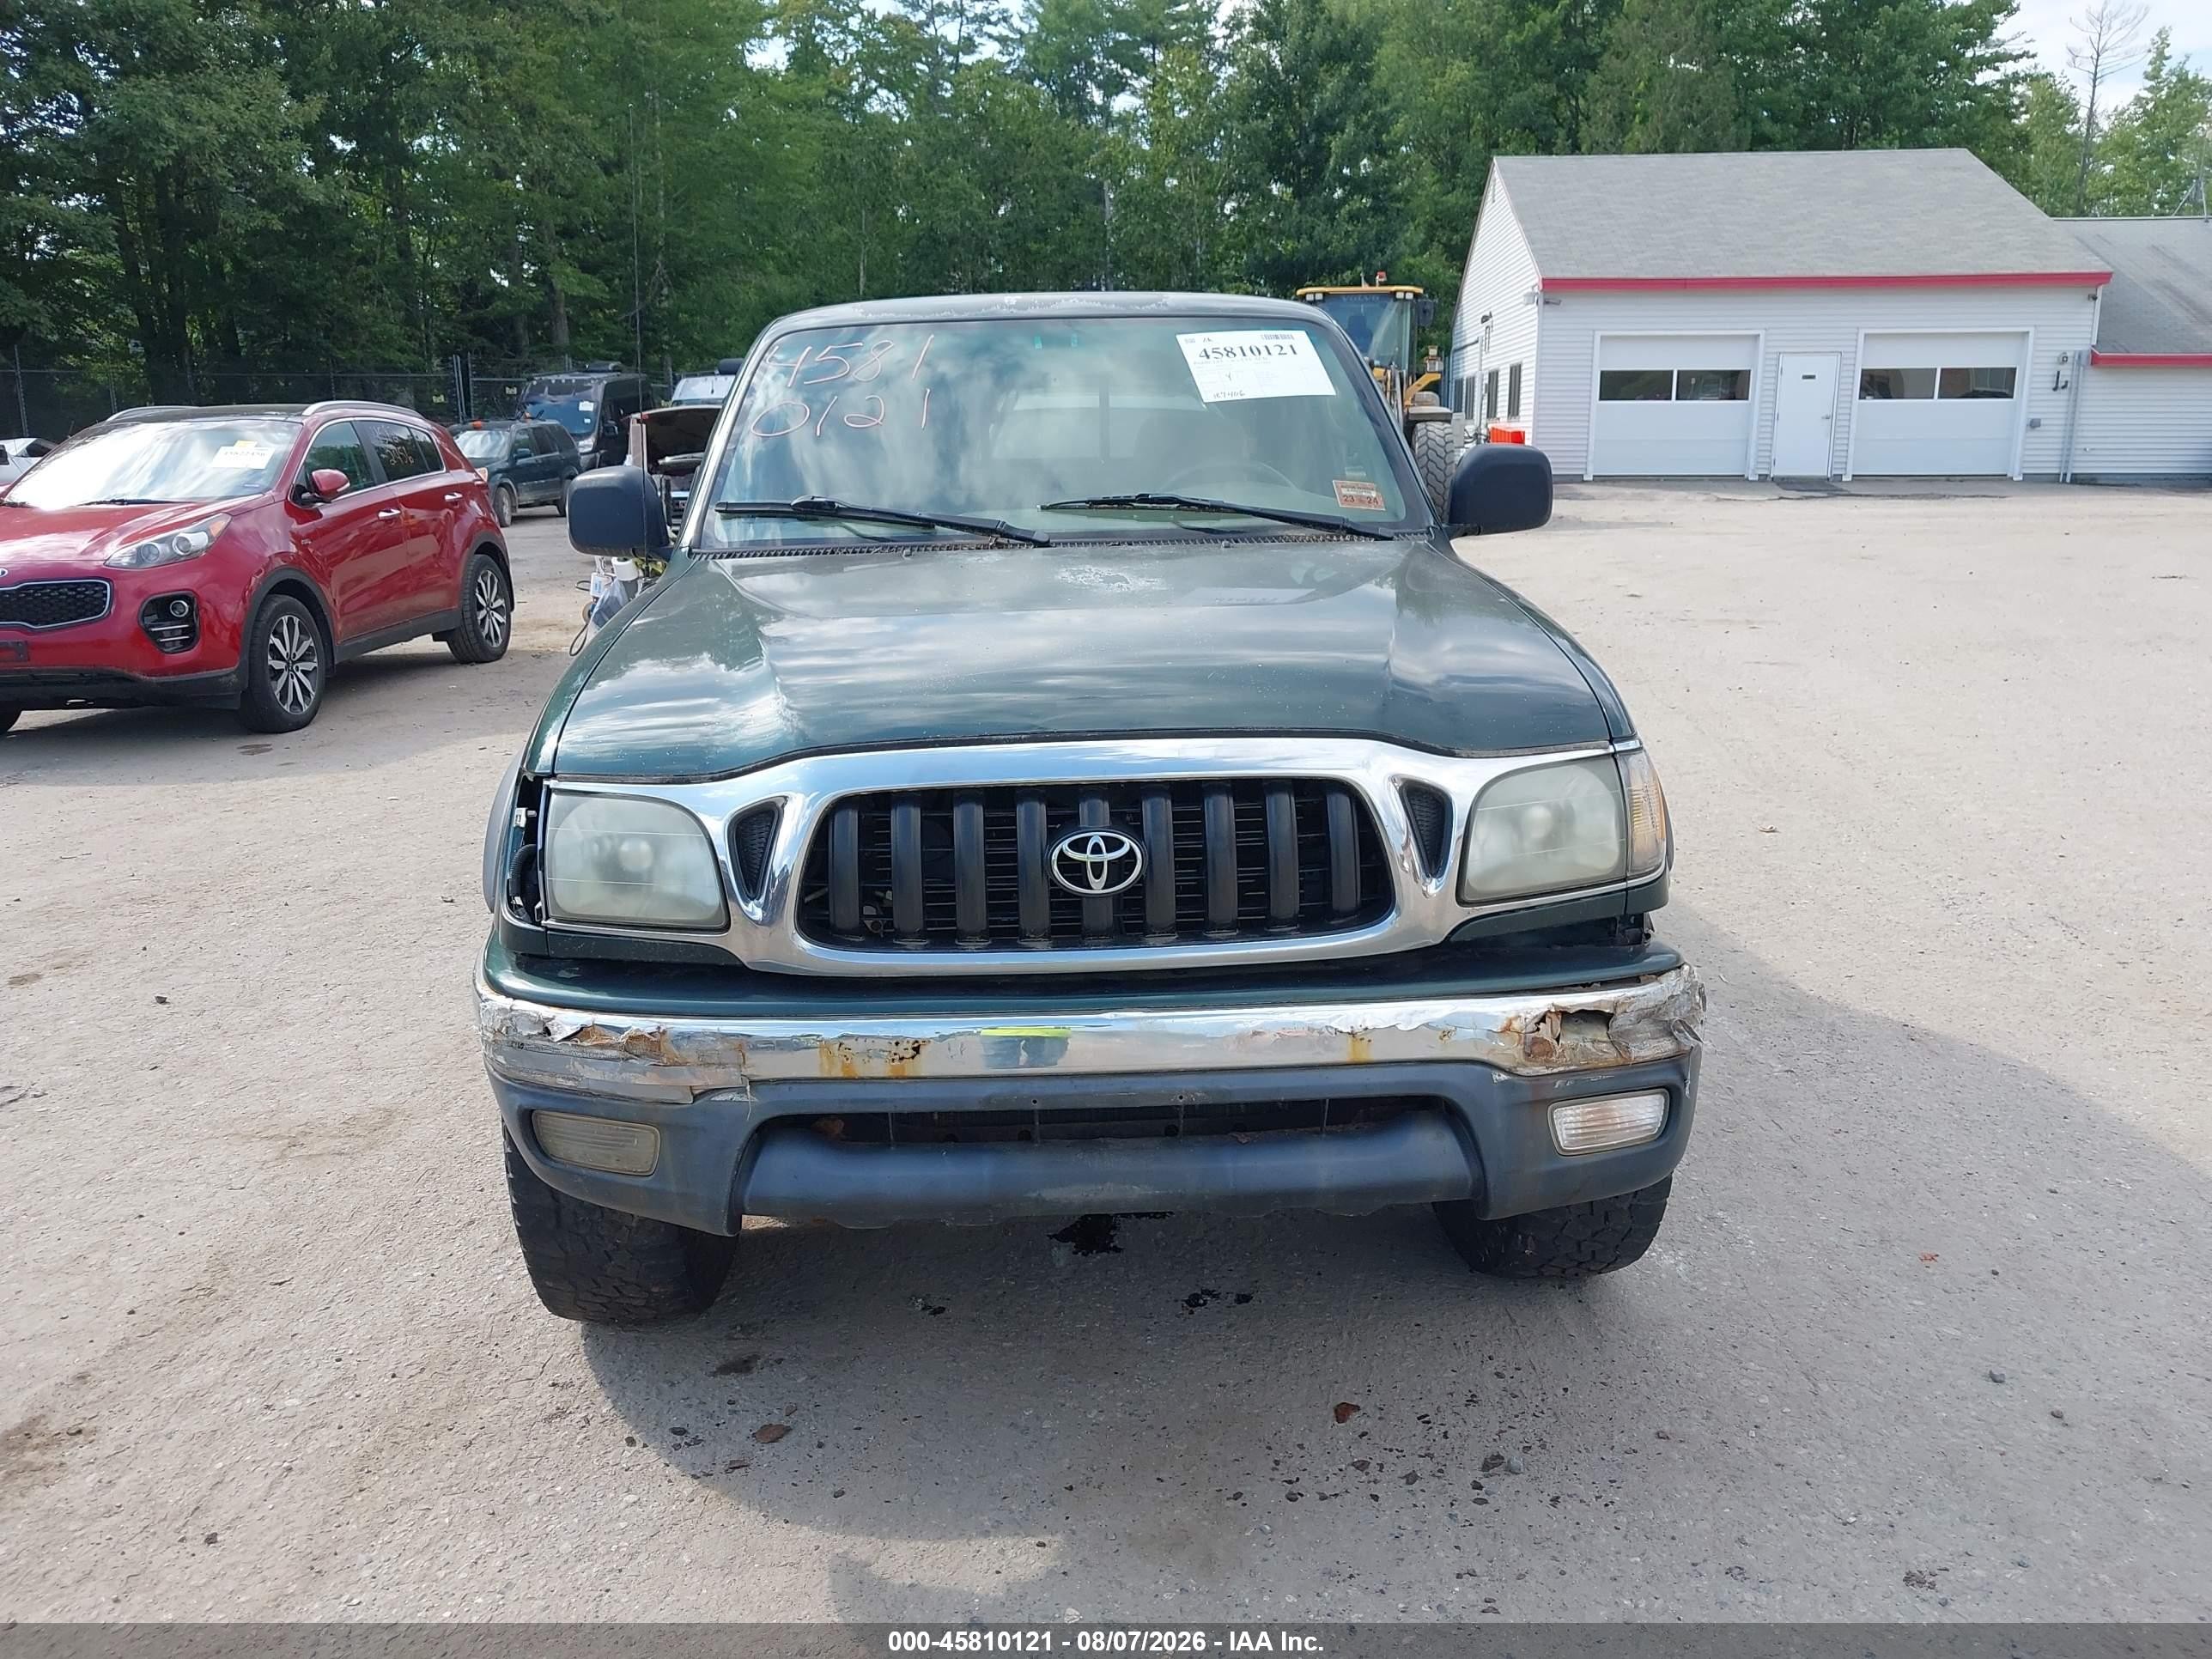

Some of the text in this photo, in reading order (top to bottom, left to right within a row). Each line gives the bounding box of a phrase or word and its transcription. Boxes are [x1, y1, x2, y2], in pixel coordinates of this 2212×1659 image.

[765, 334, 934, 388] 4581
[1199, 343, 1298, 360] 45810121
[750, 388, 931, 438] 0121
[1343, 495, 1355, 503] 23
[1366, 497, 1379, 507] 24
